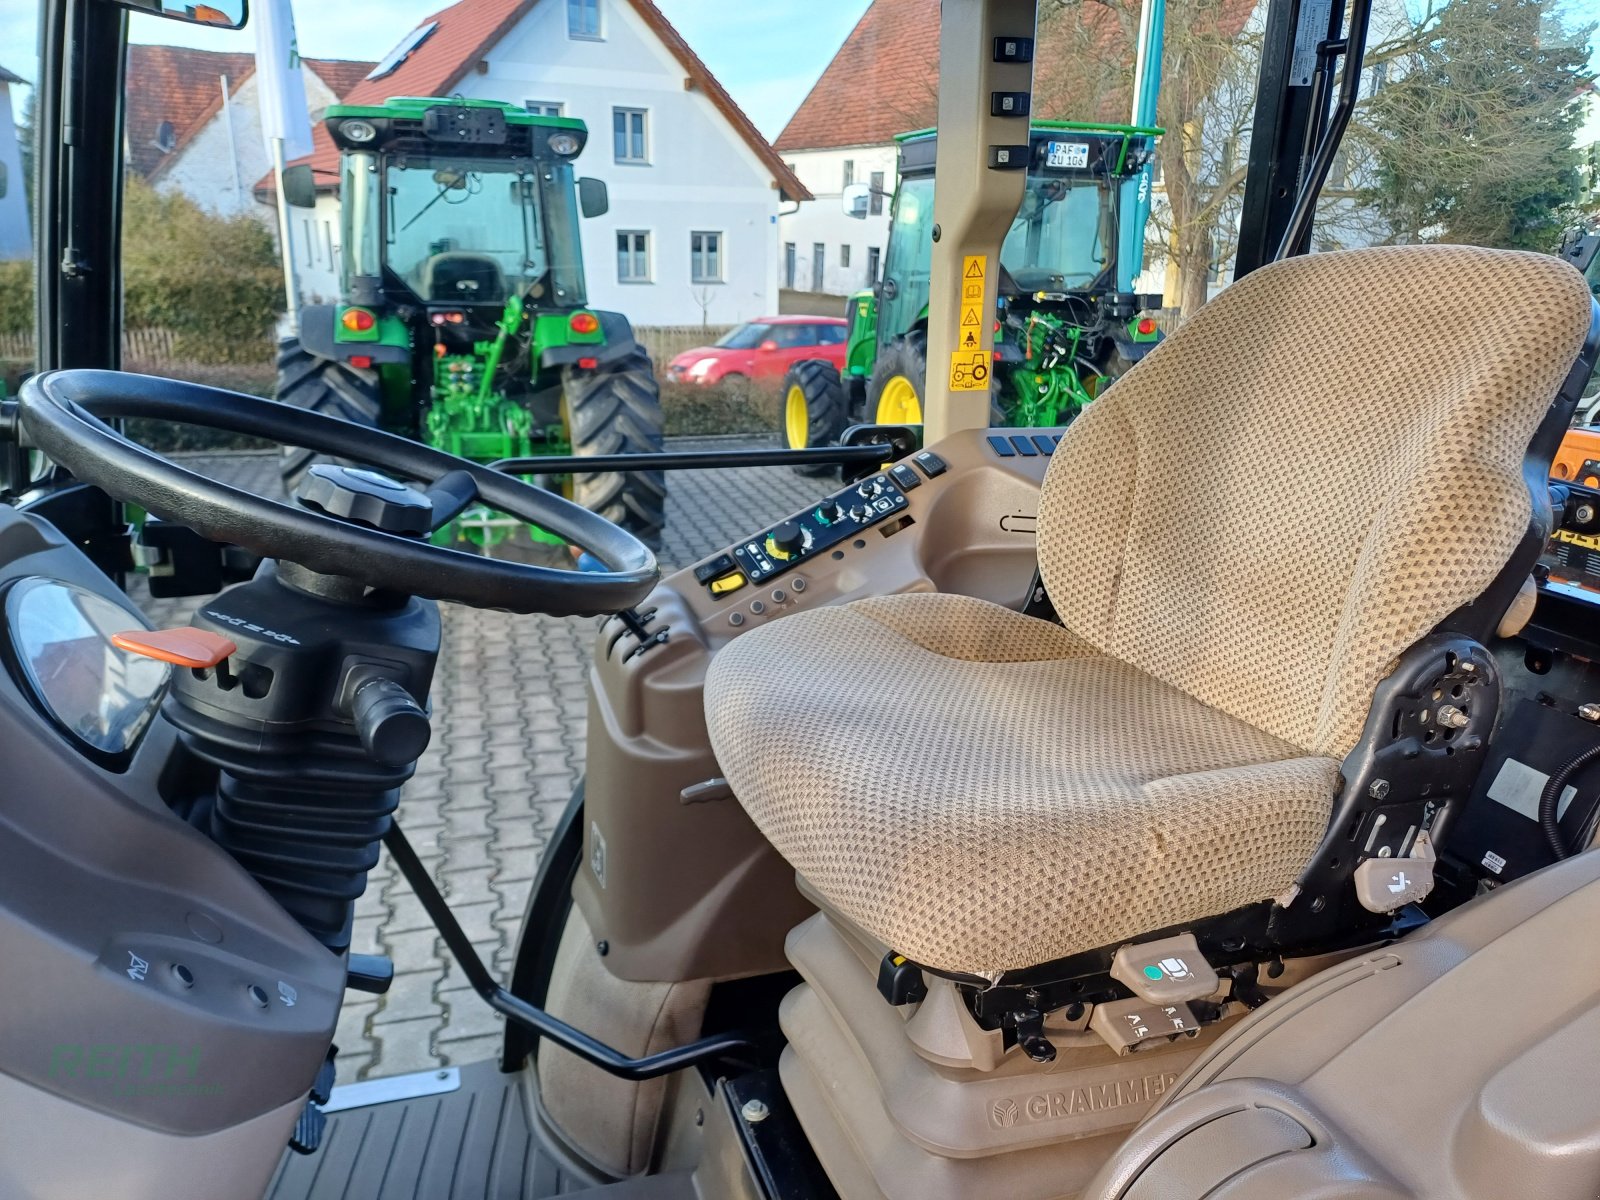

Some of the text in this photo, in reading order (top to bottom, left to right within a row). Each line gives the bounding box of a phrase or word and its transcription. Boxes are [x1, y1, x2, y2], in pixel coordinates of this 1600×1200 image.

[1056, 144, 1074, 155] PAF
[1051, 154, 1083, 166] ZU 106
